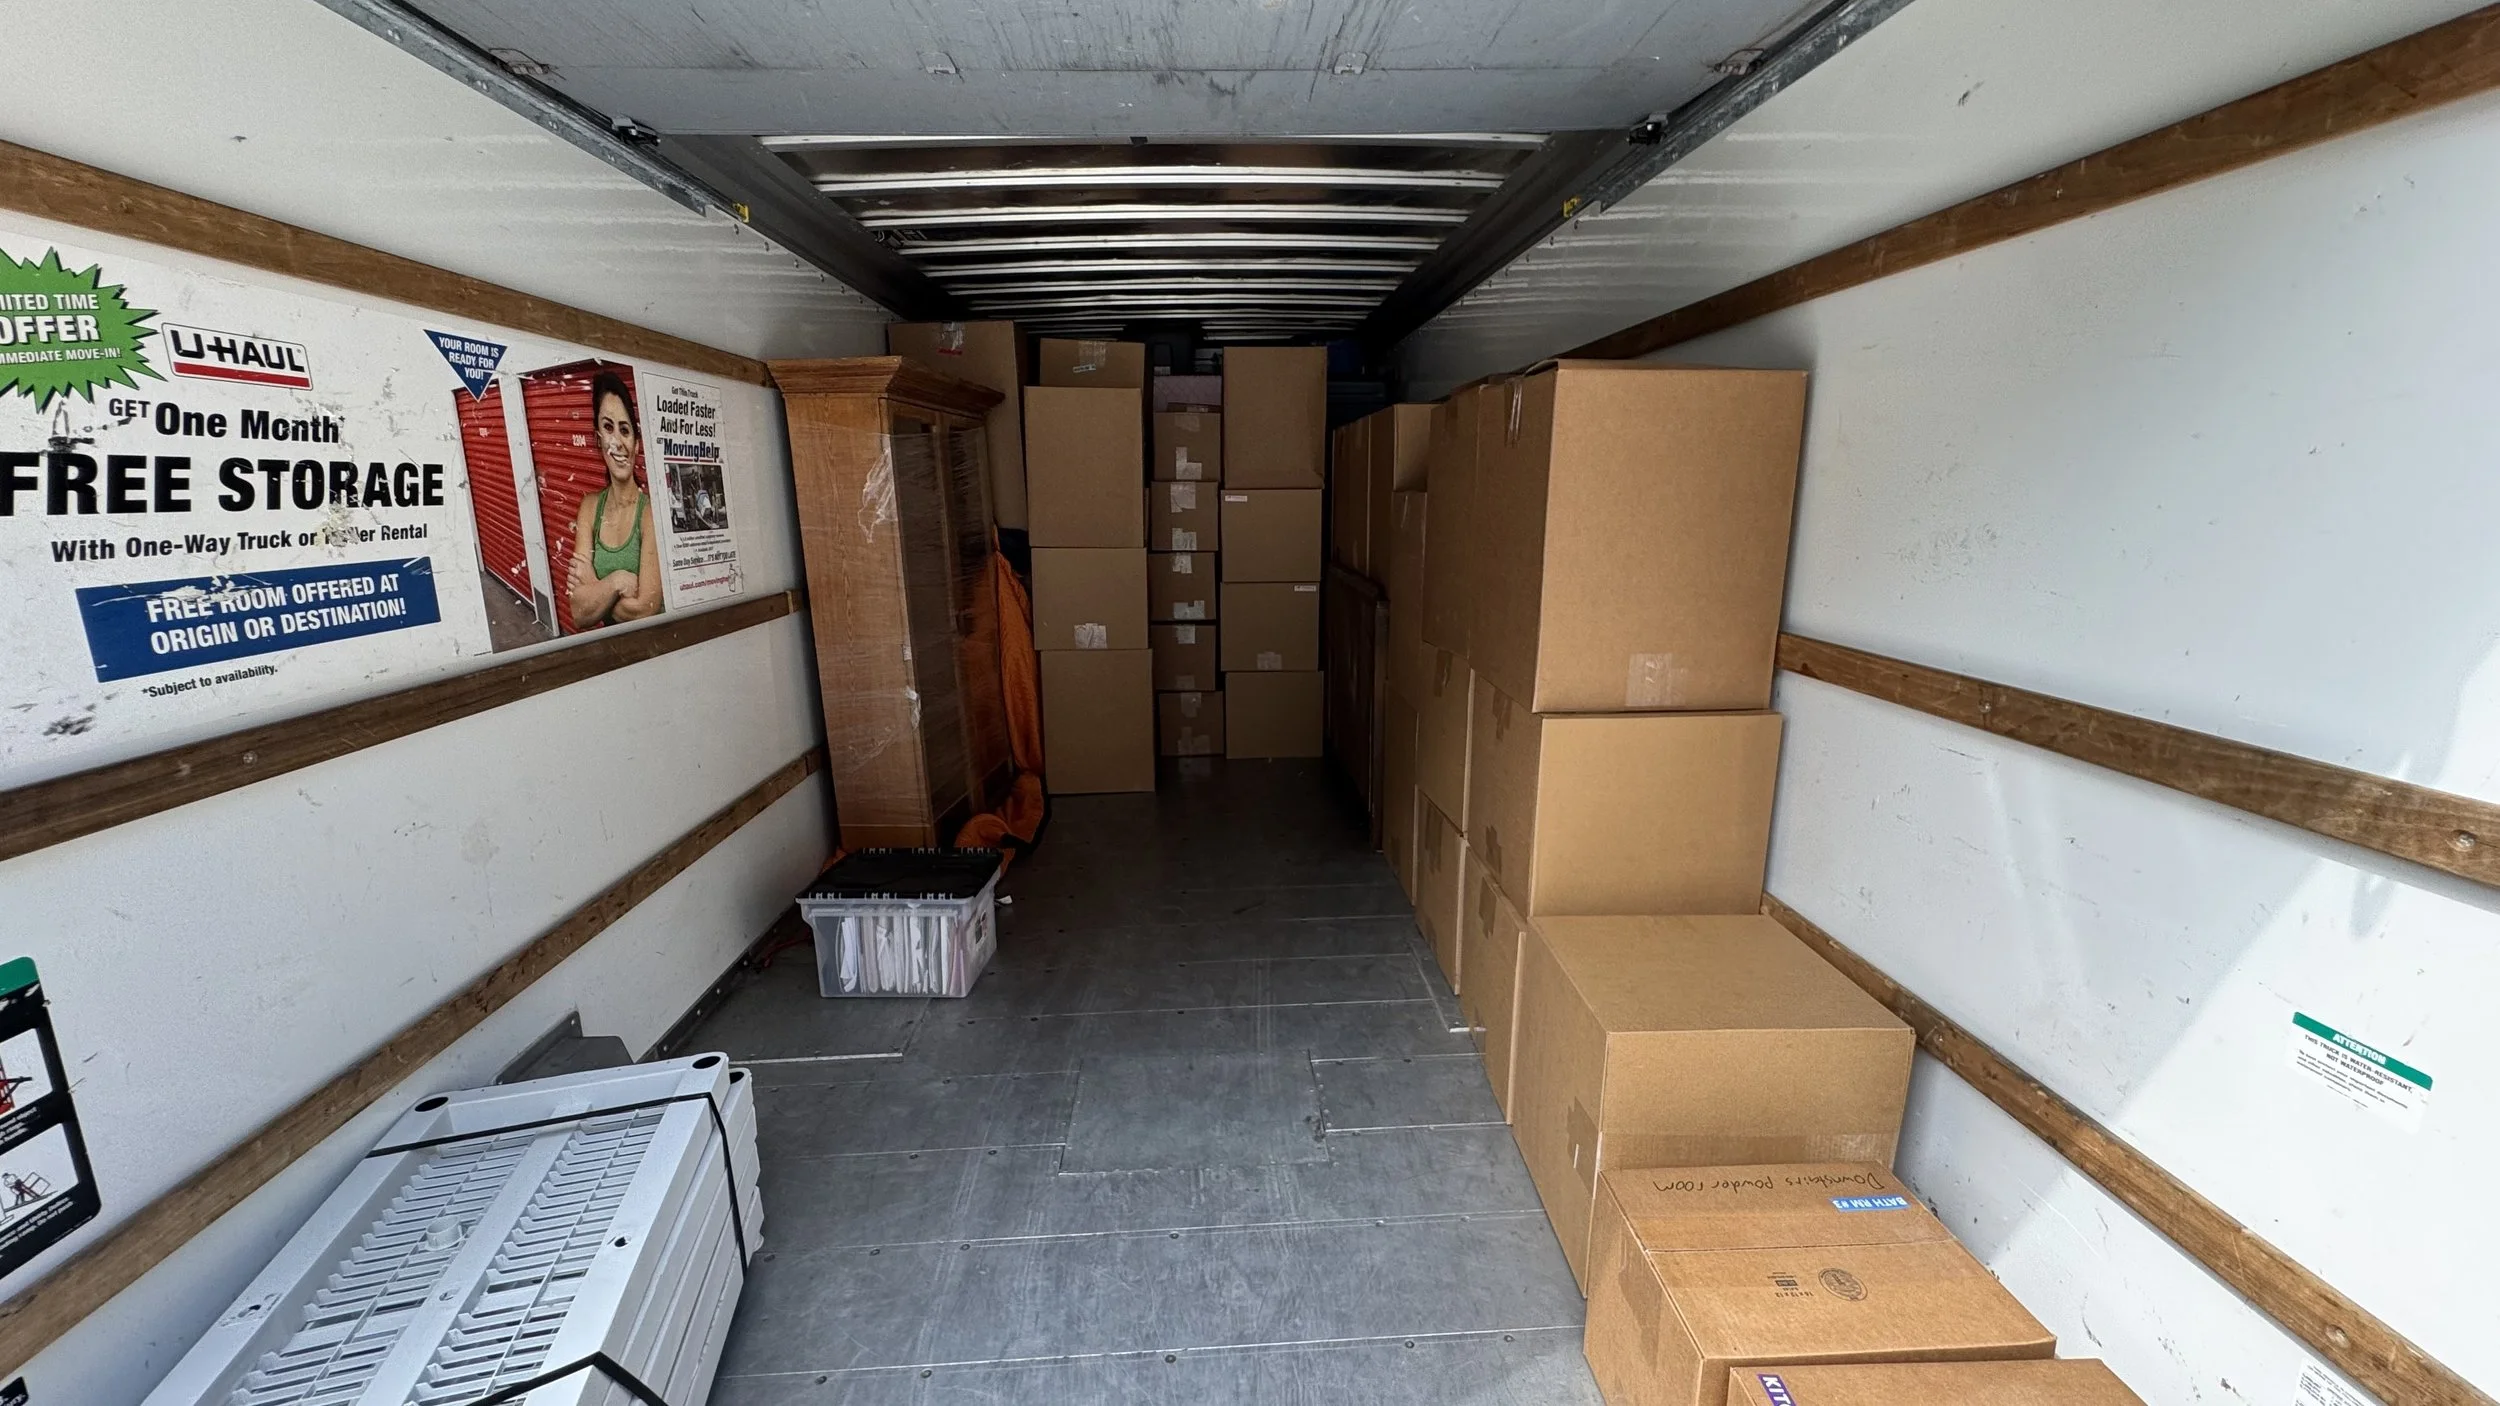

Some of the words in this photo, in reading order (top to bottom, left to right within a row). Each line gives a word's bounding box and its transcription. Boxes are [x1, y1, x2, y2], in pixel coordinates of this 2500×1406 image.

[53, 294, 100, 310] TIME
[0, 315, 101, 345] OFFER
[66, 347, 121, 360] MOVE-IN!
[438, 336, 462, 351] YOUR
[464, 342, 489, 356] ROOM
[491, 347, 499, 358] IS
[448, 351, 476, 366] READY
[478, 356, 495, 369] FOR
[464, 367, 484, 380] YOU!
[109, 398, 151, 418] GET
[155, 402, 227, 438] One
[657, 395, 689, 416] Loaded
[690, 401, 716, 419] Faster
[660, 416, 678, 434] And
[680, 418, 694, 436] For
[695, 421, 716, 438] Less!
[0, 452, 192, 516] FREE
[218, 457, 444, 512] STORAGE
[51, 539, 115, 562] With
[126, 533, 231, 555] One-Way
[237, 530, 292, 550] Truck
[299, 532, 318, 546] or
[381, 523, 428, 541] Rental
[147, 595, 213, 623] FREE
[220, 586, 287, 614] ROOM
[291, 576, 376, 604] OFFERED
[380, 573, 399, 593] AT
[150, 621, 239, 655] ORIGIN
[243, 617, 277, 640] OR
[280, 597, 407, 634] DESTINATION!
[199, 675, 213, 688] to
[215, 665, 279, 685] availability.
[2304, 1034, 2319, 1046] THIS
[2319, 1041, 2341, 1056] TRUCK
[2341, 1052, 2349, 1061] IS
[2332, 1033, 2387, 1065] ATTENTION
[2326, 1053, 2339, 1063] NOT
[2340, 1060, 2384, 1086] WATERPROOF
[1653, 1179, 1704, 1192] room
[1786, 1172, 1885, 1190] Downstairs
[1833, 1199, 1850, 1209] #3
[1851, 1197, 1870, 1209] RM
[1873, 1196, 1907, 1208] BATH
[1762, 1376, 1792, 1406] KIT
